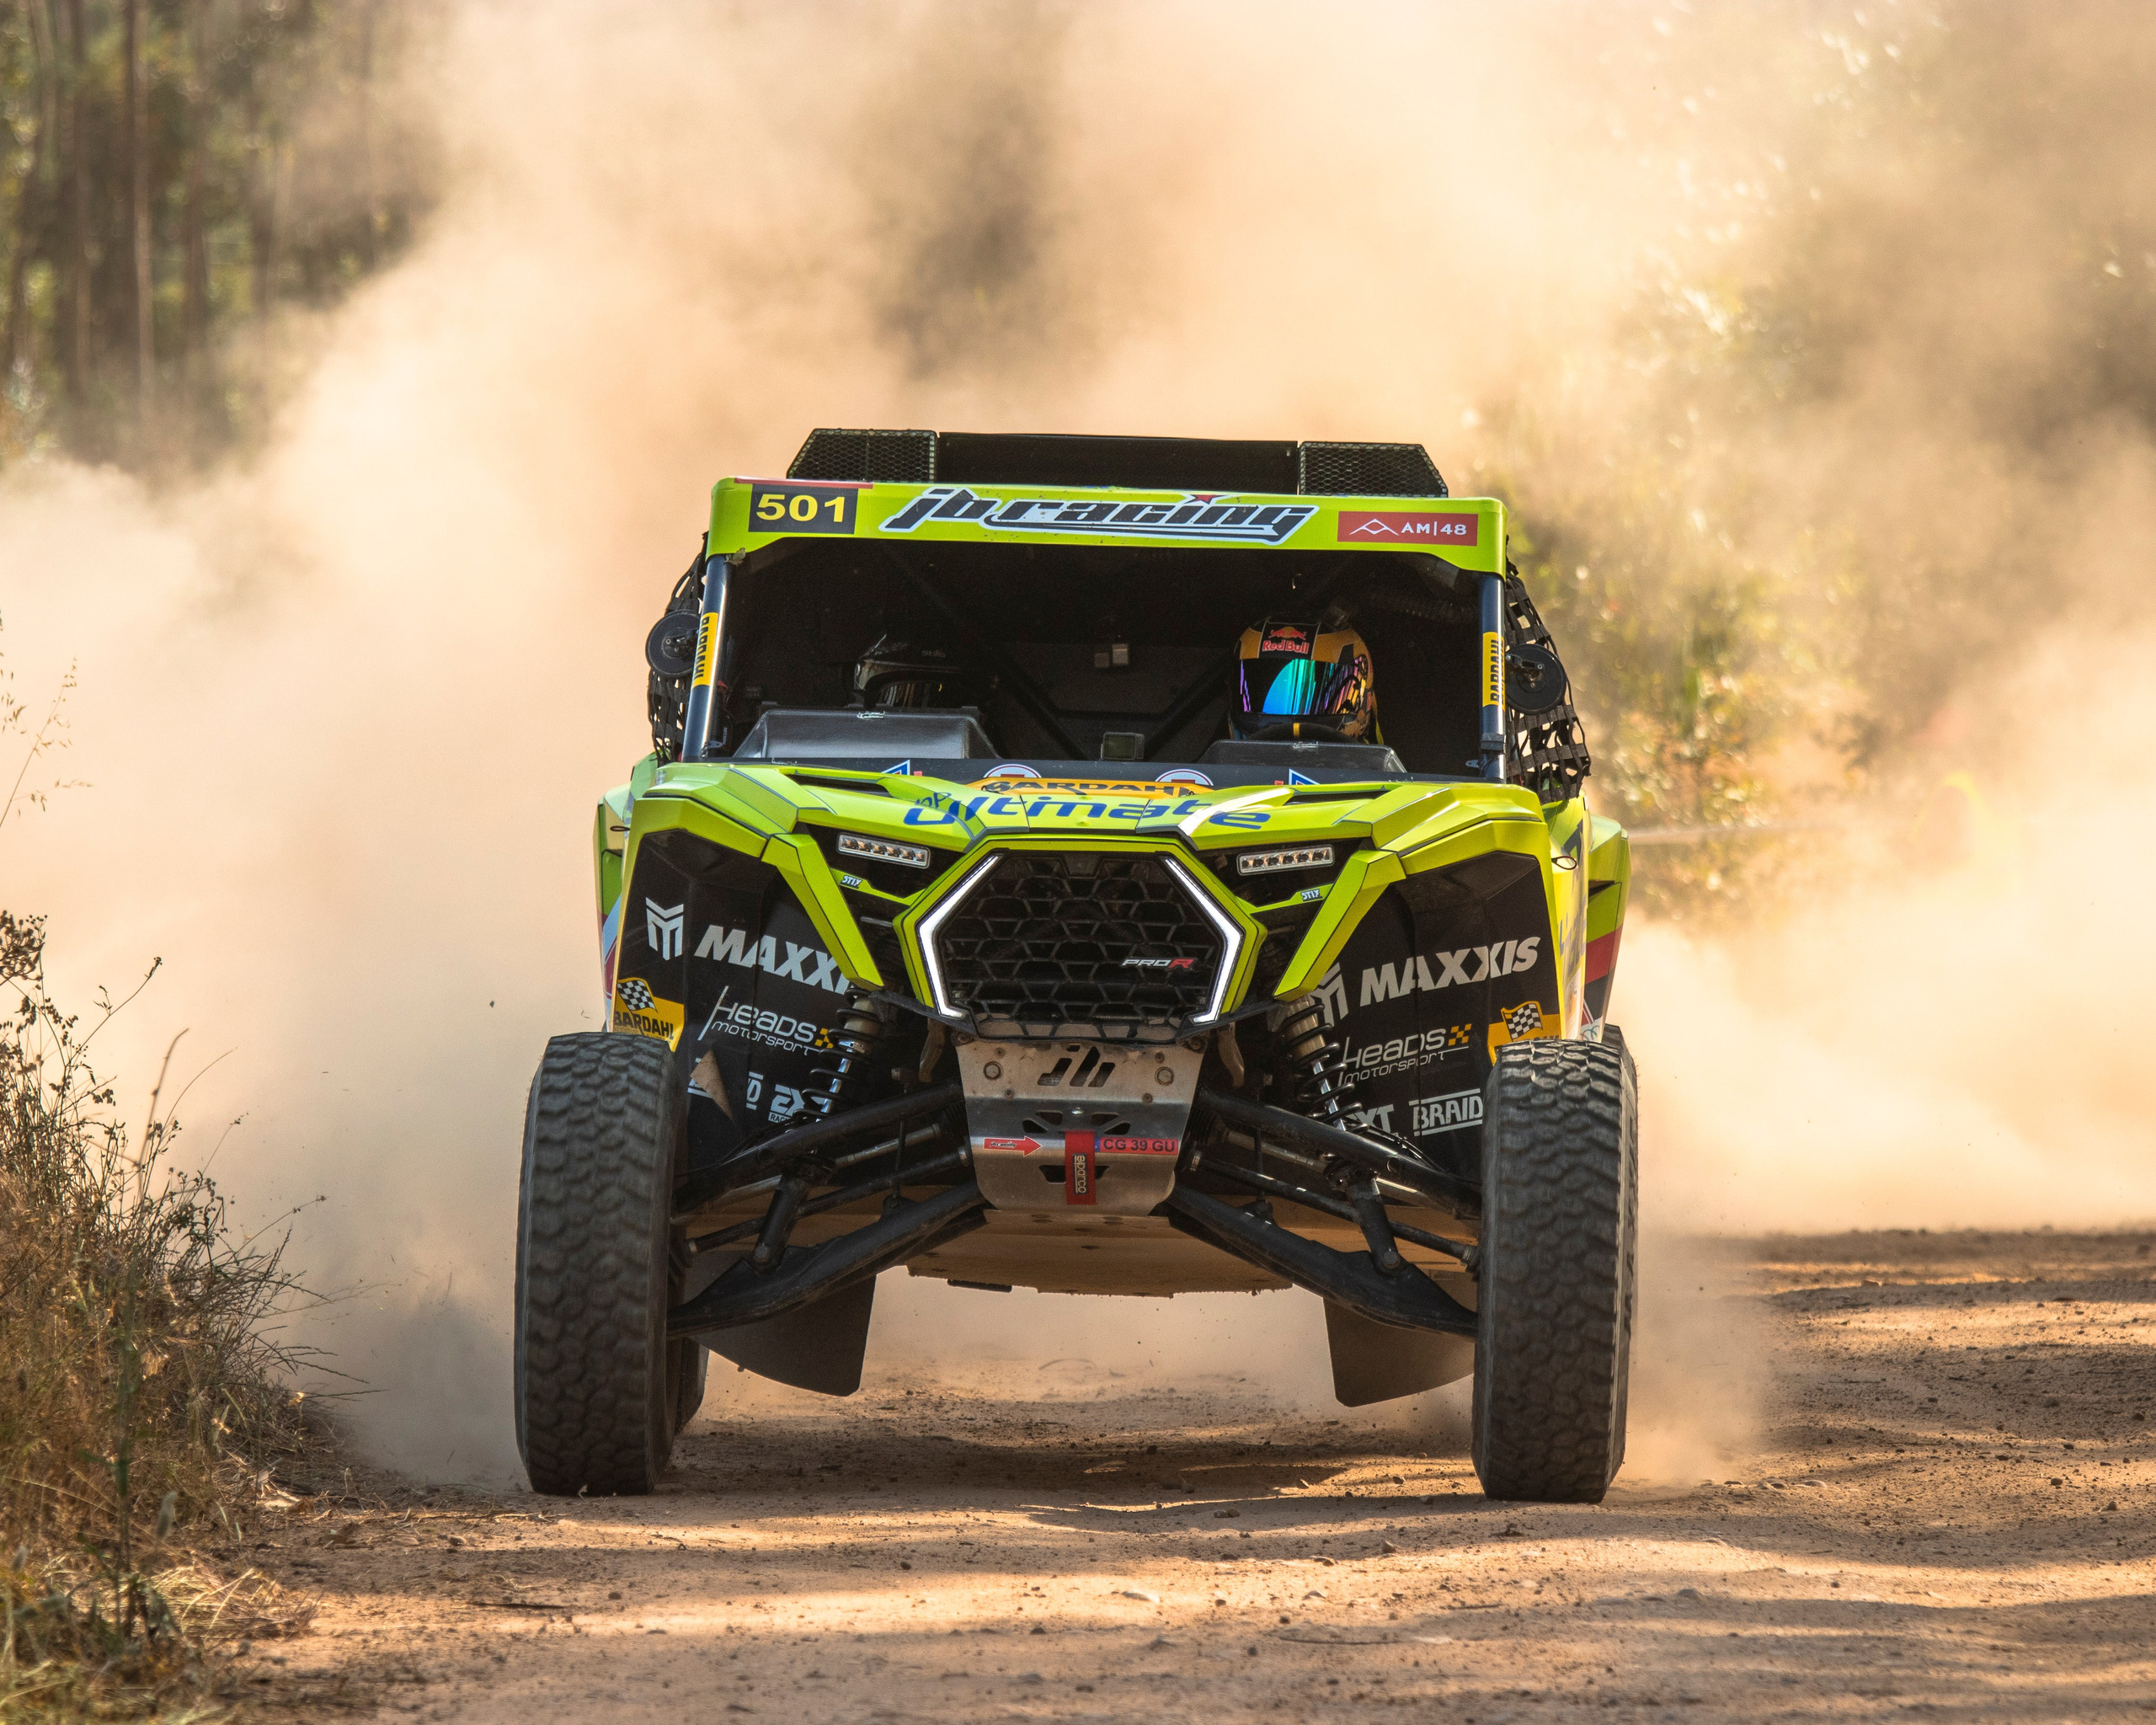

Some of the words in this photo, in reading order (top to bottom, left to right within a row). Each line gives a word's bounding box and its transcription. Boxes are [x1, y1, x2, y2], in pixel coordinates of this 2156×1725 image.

[755, 494, 846, 523] 501
[1262, 640, 1285, 651] Red
[1285, 640, 1310, 654] Bull
[694, 924, 851, 996] MAXXI
[1359, 937, 1541, 1007] MAXXIS
[614, 1011, 675, 1040] BARDAHL
[1412, 1095, 1484, 1131] BRAID
[1103, 1139, 1127, 1151] CG
[1130, 1140, 1148, 1151] 39
[1152, 1140, 1175, 1152] GU
[1074, 1155, 1087, 1194] sparco
